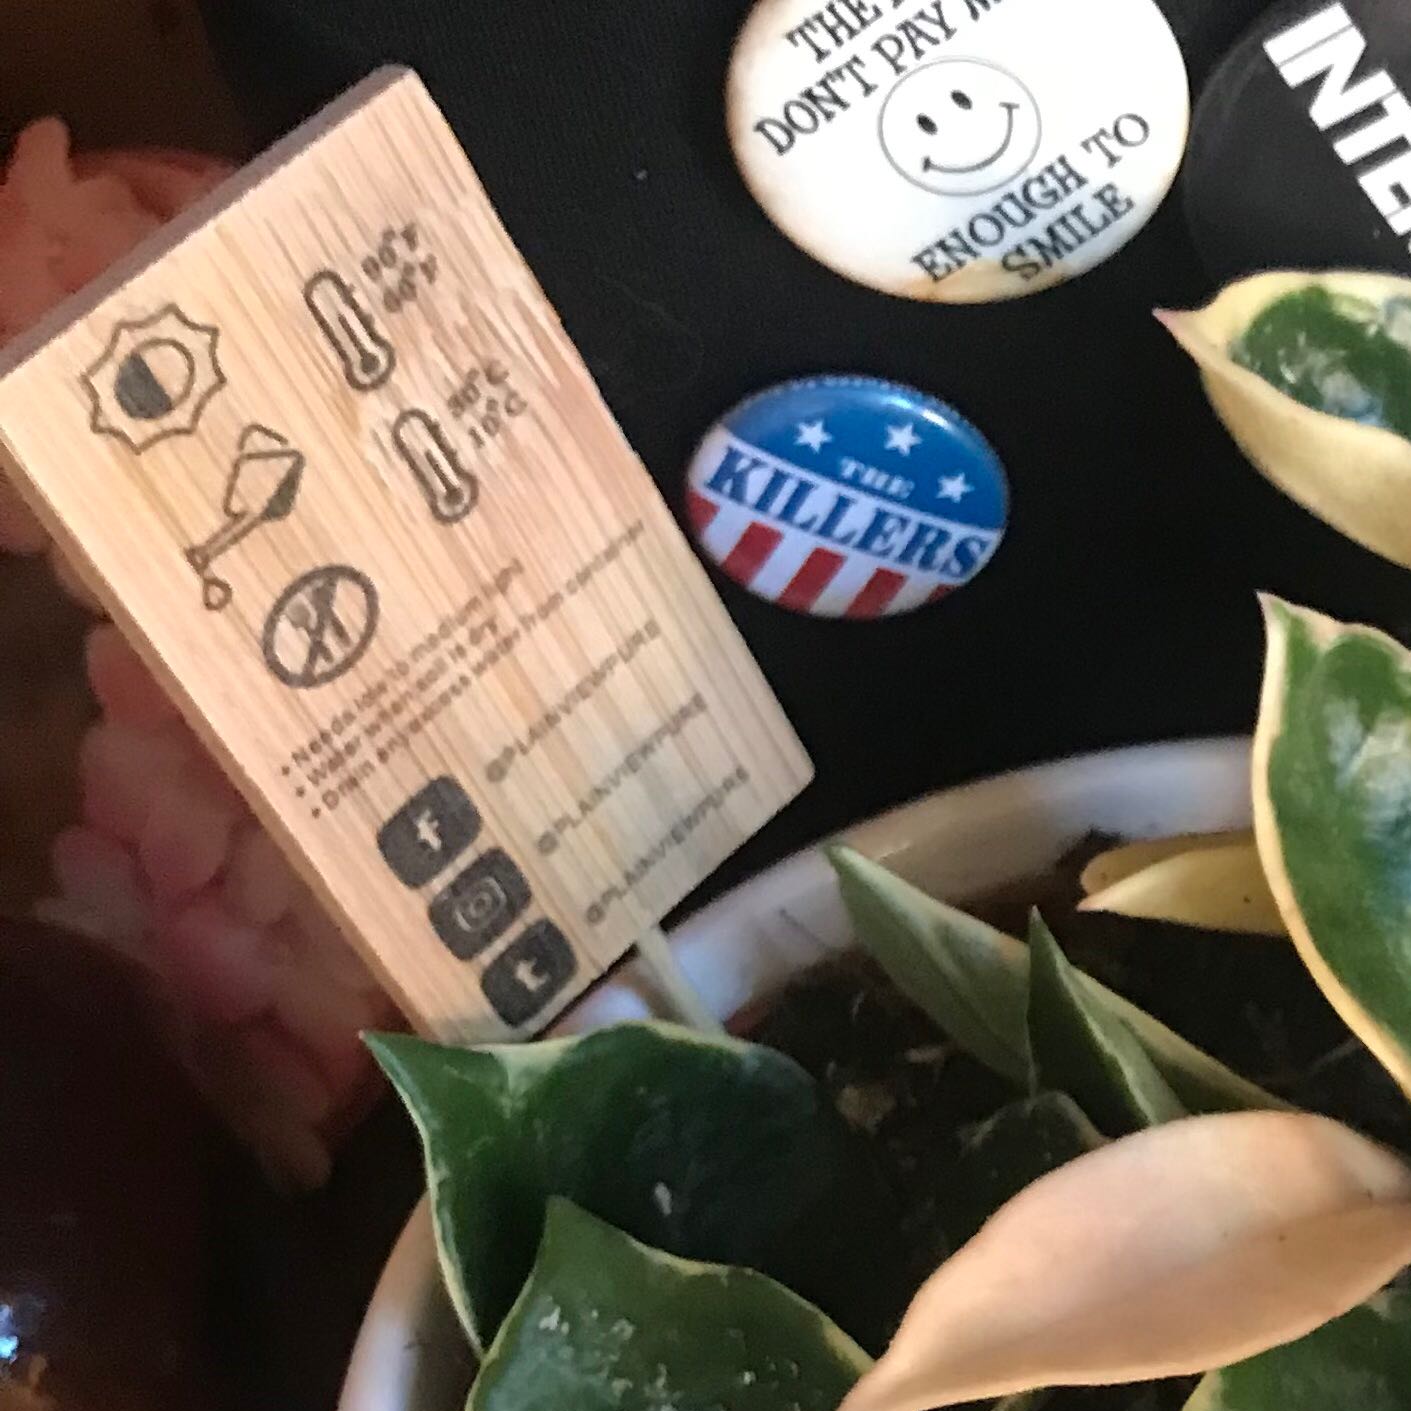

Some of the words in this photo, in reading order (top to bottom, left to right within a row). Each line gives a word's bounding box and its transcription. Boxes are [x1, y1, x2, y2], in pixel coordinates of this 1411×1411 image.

[754, 55, 878, 155] DON'T
[871, 0, 957, 76] PAY
[784, 0, 883, 62] THE
[910, 155, 1089, 282] ENOUGH
[1081, 112, 1150, 167] TO
[1001, 181, 1134, 281] SMILE
[704, 446, 989, 579] KILLERS
[840, 456, 916, 500] THE
